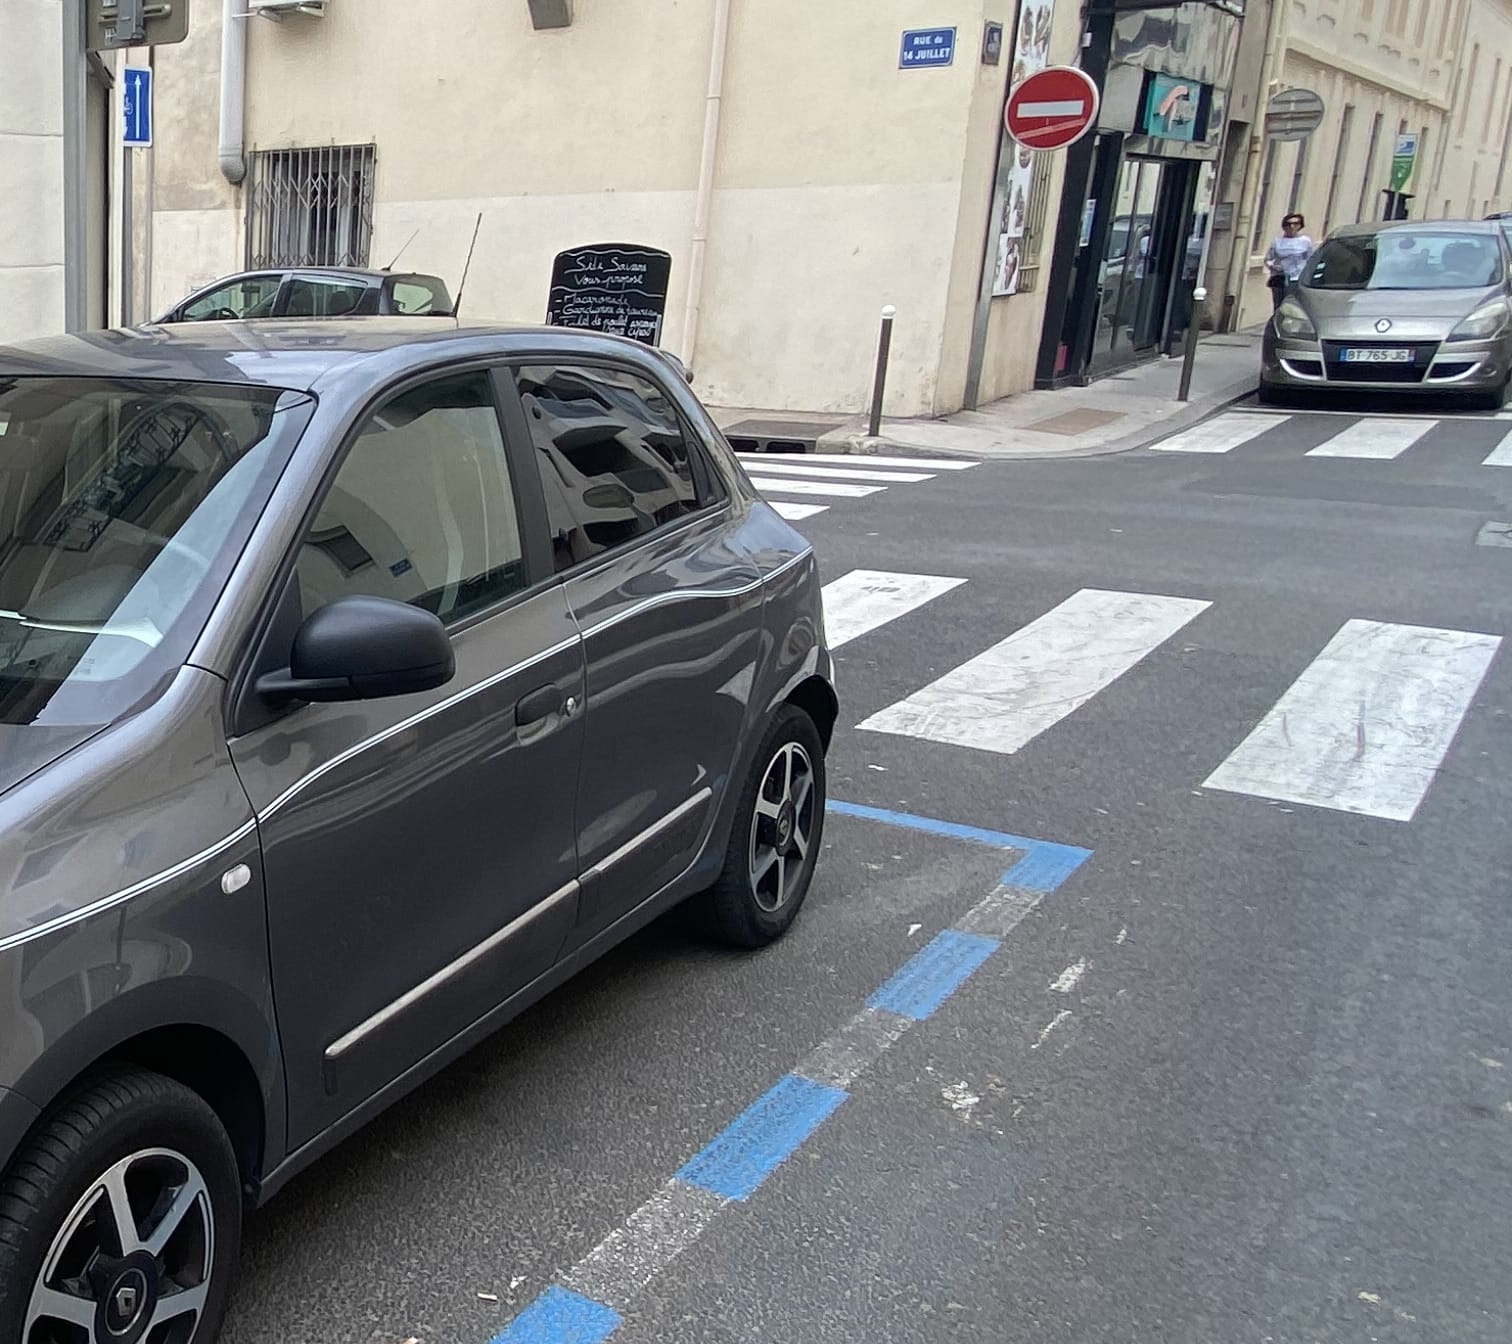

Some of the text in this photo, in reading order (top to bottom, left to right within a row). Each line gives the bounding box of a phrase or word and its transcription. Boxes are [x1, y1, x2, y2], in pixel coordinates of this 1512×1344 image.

[913, 36, 931, 45] RUE
[904, 48, 950, 60] 14 JUILLET
[1366, 350, 1388, 360] 765
